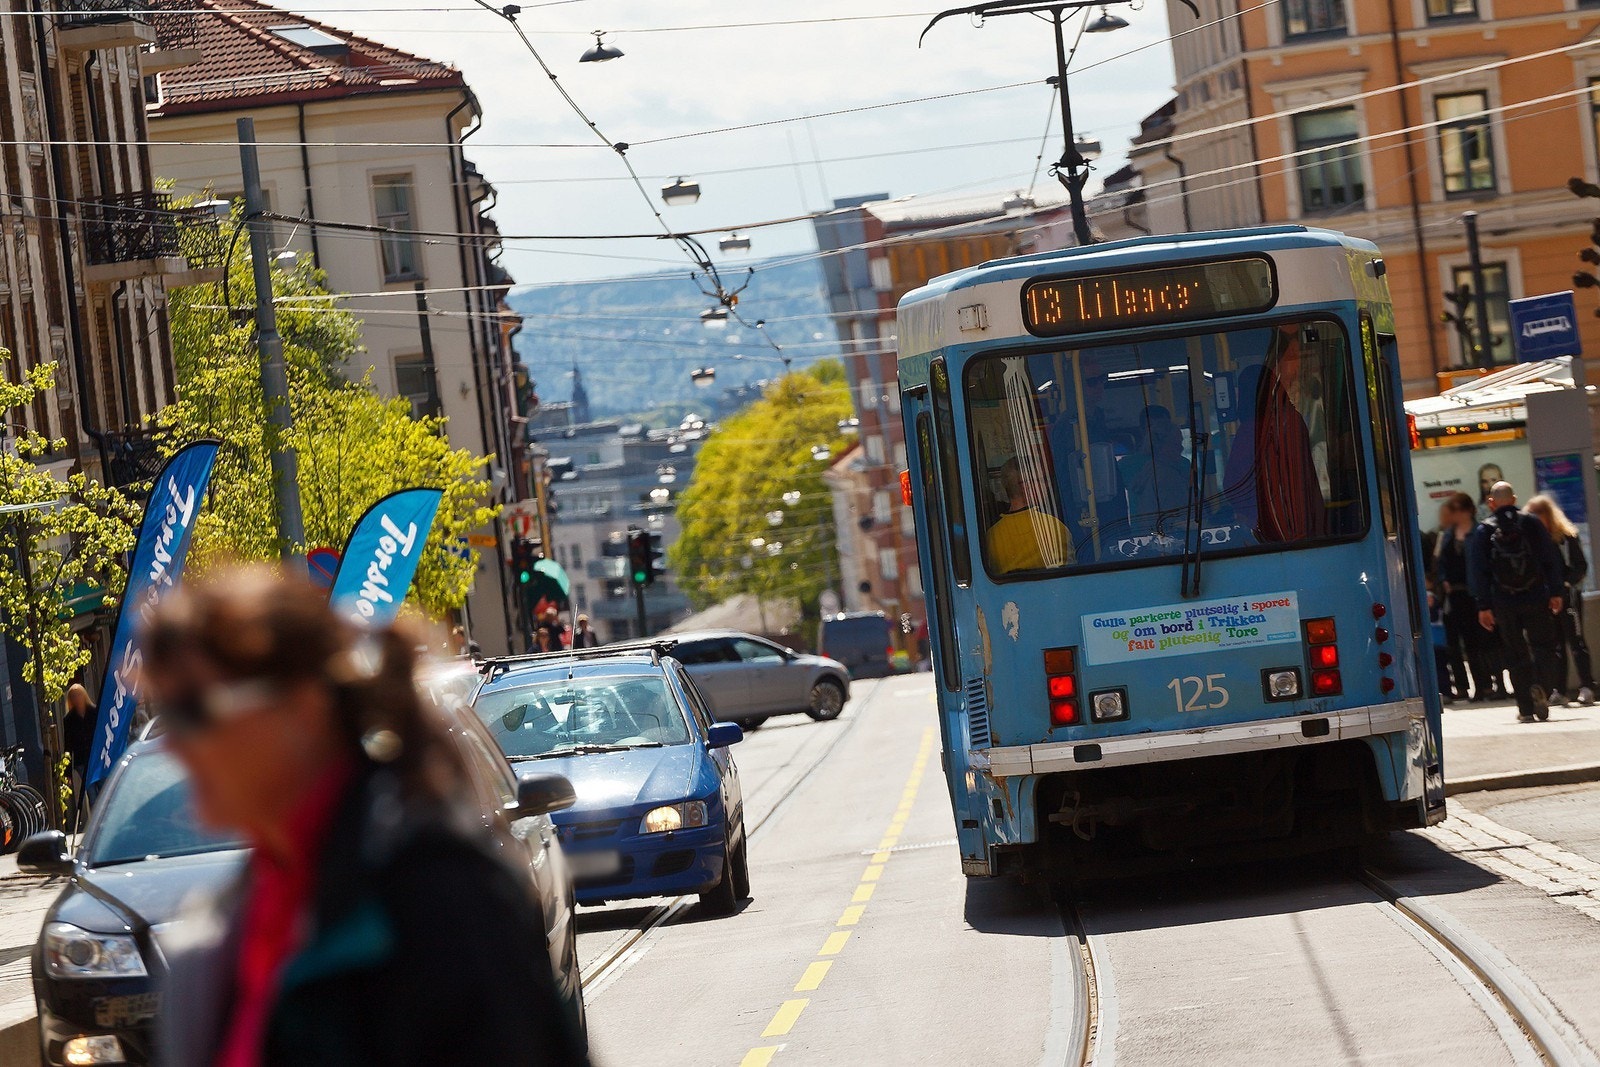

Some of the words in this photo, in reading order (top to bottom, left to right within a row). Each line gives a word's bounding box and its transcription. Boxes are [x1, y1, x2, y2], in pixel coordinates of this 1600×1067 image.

[1026, 288, 1062, 325] 13
[1093, 617, 1127, 628] Gulla
[1129, 610, 1182, 627] parkerte
[1185, 604, 1239, 620] plutselig
[1243, 602, 1248, 611] i
[1251, 598, 1290, 612] sporet
[1112, 630, 1129, 642] og
[1134, 626, 1156, 637] om
[1160, 620, 1194, 634] bord
[1198, 619, 1204, 630] i
[1208, 613, 1266, 627] Trikken
[1128, 639, 1155, 652] falt
[1159, 631, 1221, 650] plutselig
[1226, 627, 1258, 638] Tore
[1167, 673, 1229, 713] 125
